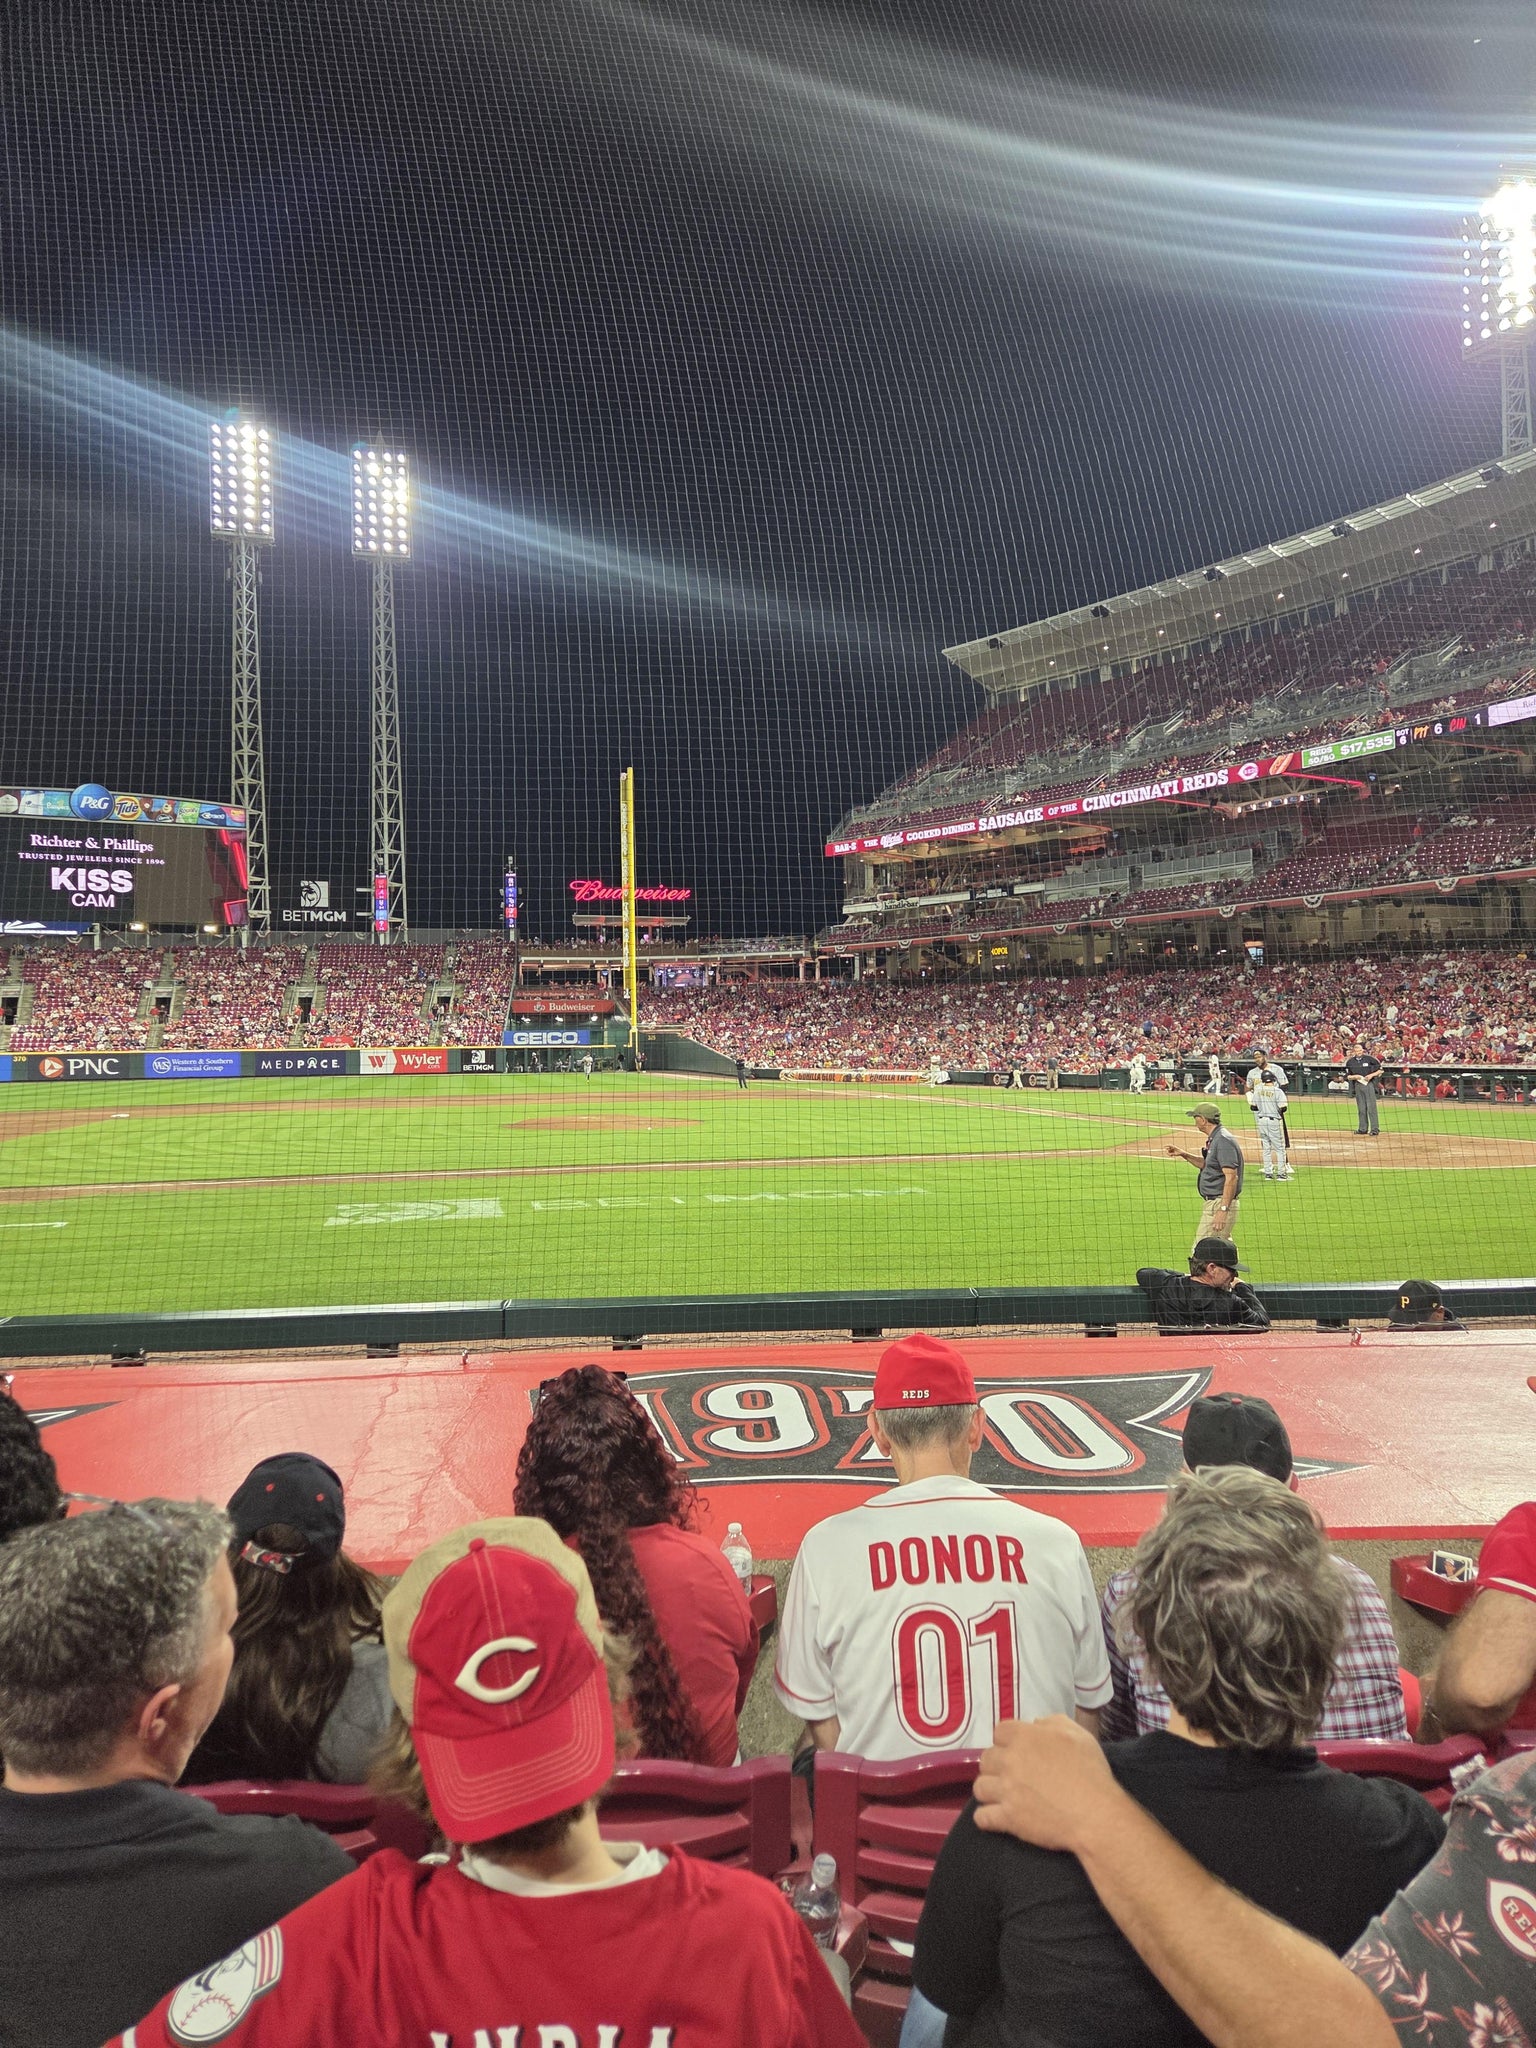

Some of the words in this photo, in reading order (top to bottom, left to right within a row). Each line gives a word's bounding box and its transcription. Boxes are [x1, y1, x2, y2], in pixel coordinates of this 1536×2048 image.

[1449, 717, 1467, 733] CIN
[1474, 713, 1481, 725] 1
[1413, 725, 1430, 741] PIT
[1434, 723, 1443, 735] 6
[1340, 736, 1393, 756] $17,535
[1399, 736, 1407, 745] 6
[1308, 754, 1335, 765] 50/50
[1309, 747, 1333, 758] REDS
[80, 795, 110, 810] P&G
[117, 801, 139, 816] Tide
[834, 841, 857, 852] BAR-S
[863, 839, 878, 848] THE
[906, 827, 941, 842] COOKED
[942, 821, 976, 839] DINNER
[978, 808, 1044, 831] SAUSAGE
[1048, 806, 1059, 817] OF
[1060, 803, 1078, 814] THE
[1082, 779, 1180, 812] CINCINNATI
[1182, 768, 1229, 792] REDS
[30, 834, 81, 849] Richter
[85, 837, 101, 849] &
[103, 838, 154, 853] Phillips
[18, 852, 63, 861] TRUSTED
[65, 854, 113, 863] JEWELERS
[51, 866, 133, 893] KISS
[71, 893, 116, 908] CAM
[282, 910, 347, 922] BETMGM
[549, 1003, 596, 1011] Budweiser
[513, 1031, 579, 1045] GEICO
[67, 1058, 119, 1076] PNC
[261, 1057, 340, 1070] MEDPACE
[401, 1053, 443, 1069] Wyler
[1401, 1295, 1410, 1309] P
[902, 1389, 930, 1400] REDS
[634, 1379, 1136, 1473] 90
[868, 1534, 1029, 1592] DONOR
[454, 1636, 541, 1704] C
[891, 1600, 1021, 1747] 01
